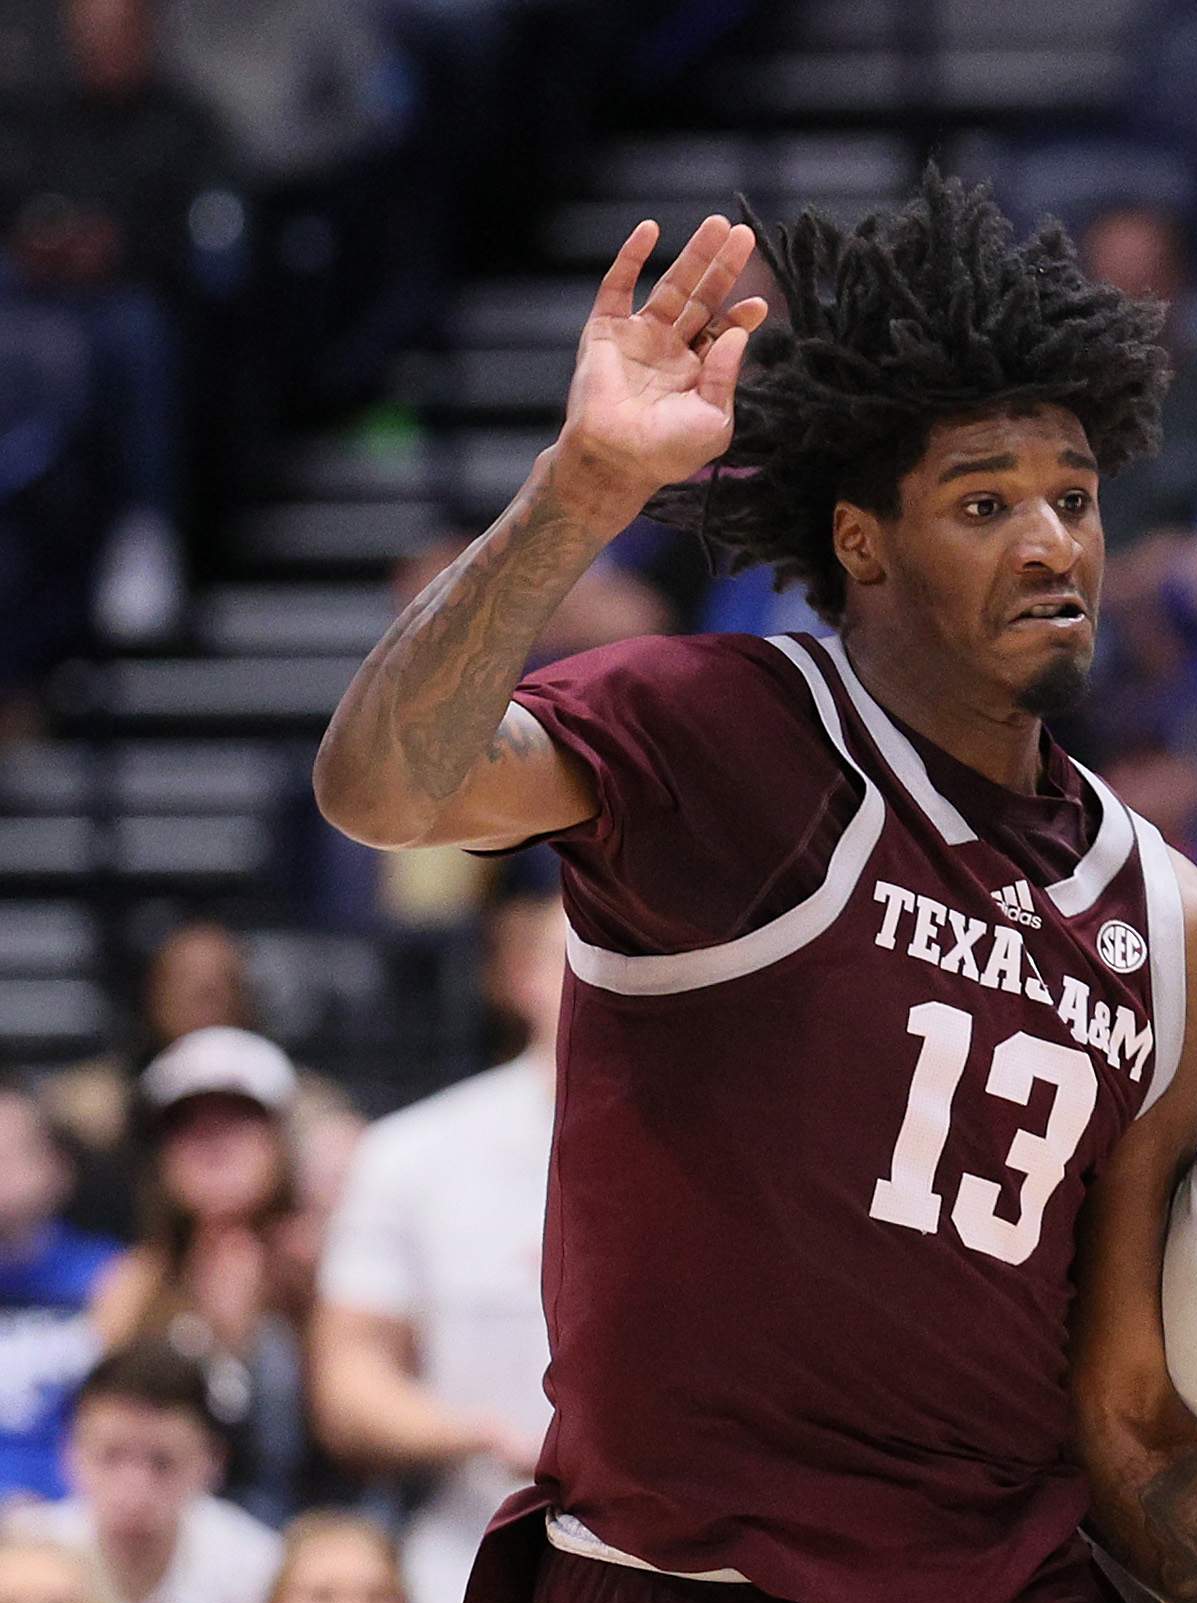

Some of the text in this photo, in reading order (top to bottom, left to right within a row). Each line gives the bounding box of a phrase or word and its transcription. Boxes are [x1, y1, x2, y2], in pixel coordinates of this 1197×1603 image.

[996, 901, 1042, 929] idas
[1101, 925, 1142, 969] SEC
[1057, 975, 1154, 1083] A&M
[869, 1001, 1099, 1266] 13
